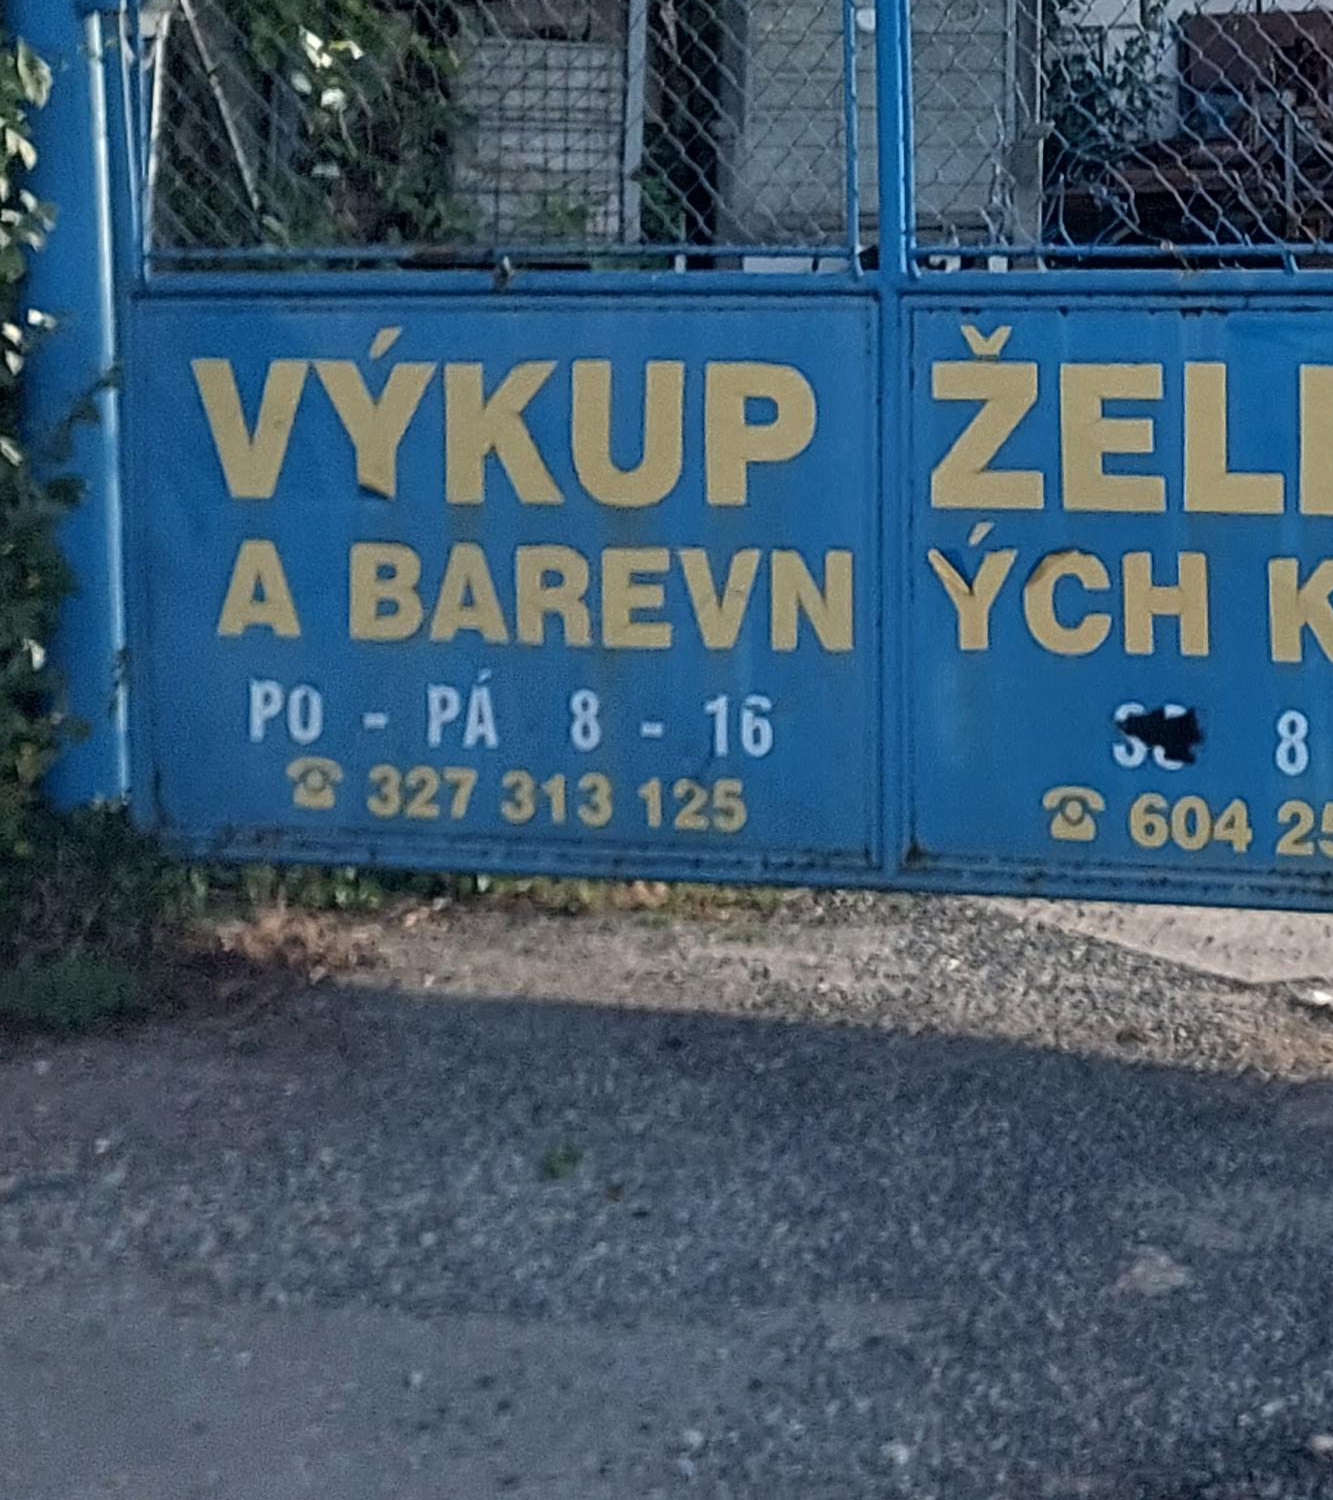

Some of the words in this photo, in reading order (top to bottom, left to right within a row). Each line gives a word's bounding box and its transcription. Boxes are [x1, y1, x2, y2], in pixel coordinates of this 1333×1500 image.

[191, 327, 817, 506] VÝKUP
[218, 539, 301, 639] A
[348, 541, 854, 652] BAREVN
[928, 522, 1209, 657] ÝCH
[249, 679, 322, 744] PO
[428, 670, 500, 749] PÁ
[570, 689, 601, 752] 8
[705, 695, 774, 757] 16
[1276, 710, 1308, 775] 8
[367, 765, 479, 819] 327
[501, 771, 613, 826] 313
[639, 778, 747, 834] 125
[1129, 793, 1252, 852] 604
